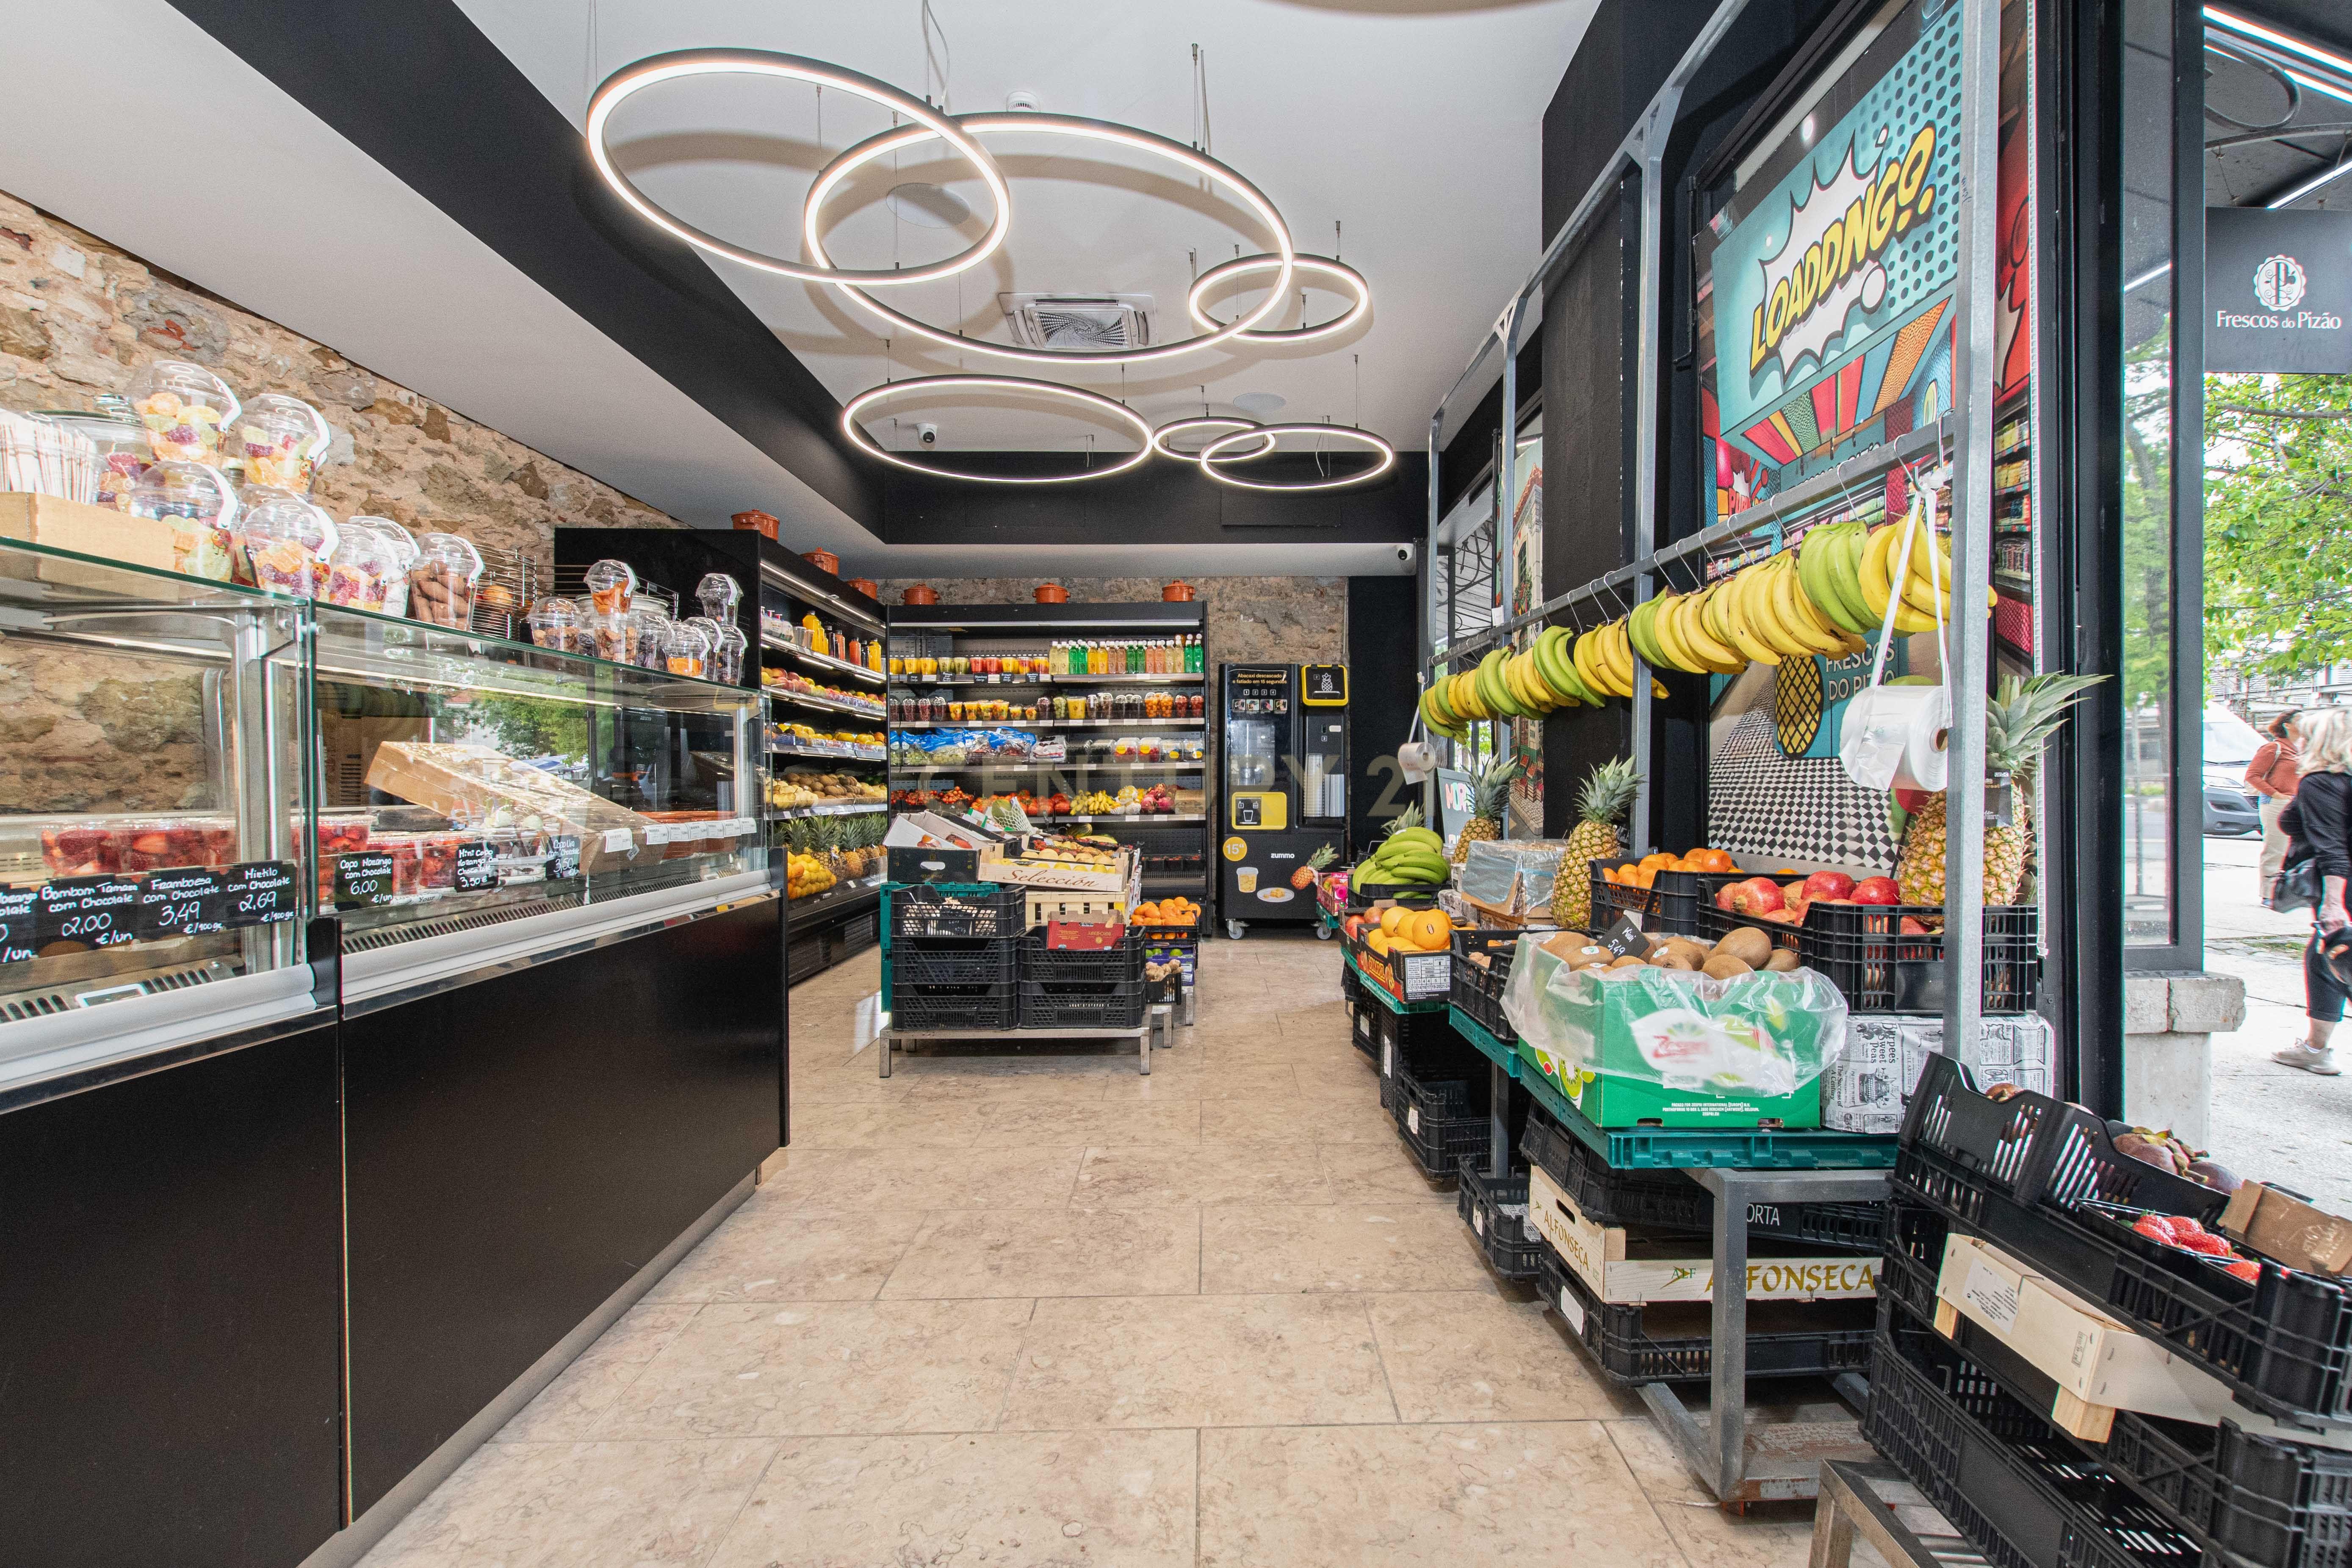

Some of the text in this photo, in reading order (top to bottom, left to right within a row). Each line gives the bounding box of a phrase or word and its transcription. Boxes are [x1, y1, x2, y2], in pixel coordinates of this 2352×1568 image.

[2216, 310, 2342, 329] Frescos do Pizão
[1829, 678, 1849, 701] DO
[458, 849, 475, 858] Mini
[245, 867, 279, 880] Mirtilo
[340, 857, 392, 871] Copo Morango
[345, 867, 392, 879] com Chocolate
[553, 857, 574, 873] 3,50
[151, 877, 213, 890] Framboesa
[227, 876, 291, 892] com Chocolate
[350, 879, 378, 895] 6,00
[1002, 869, 1099, 887] Selección
[41, 885, 96, 901] Bombom
[142, 885, 220, 904] com Chocolate
[238, 890, 277, 912] 2,69
[48, 893, 133, 913] com Chocolate
[158, 901, 200, 926] 3,49
[61, 913, 112, 937] 2,00
[1622, 926, 1636, 943] Kiwi
[1870, 1041, 1879, 1063] Peas
[1878, 1034, 1887, 1063] Sweet
[1746, 1204, 1780, 1226] ORTA
[1544, 1210, 1589, 1271] ALFONSECA
[1704, 1263, 1877, 1293] FONSECA
